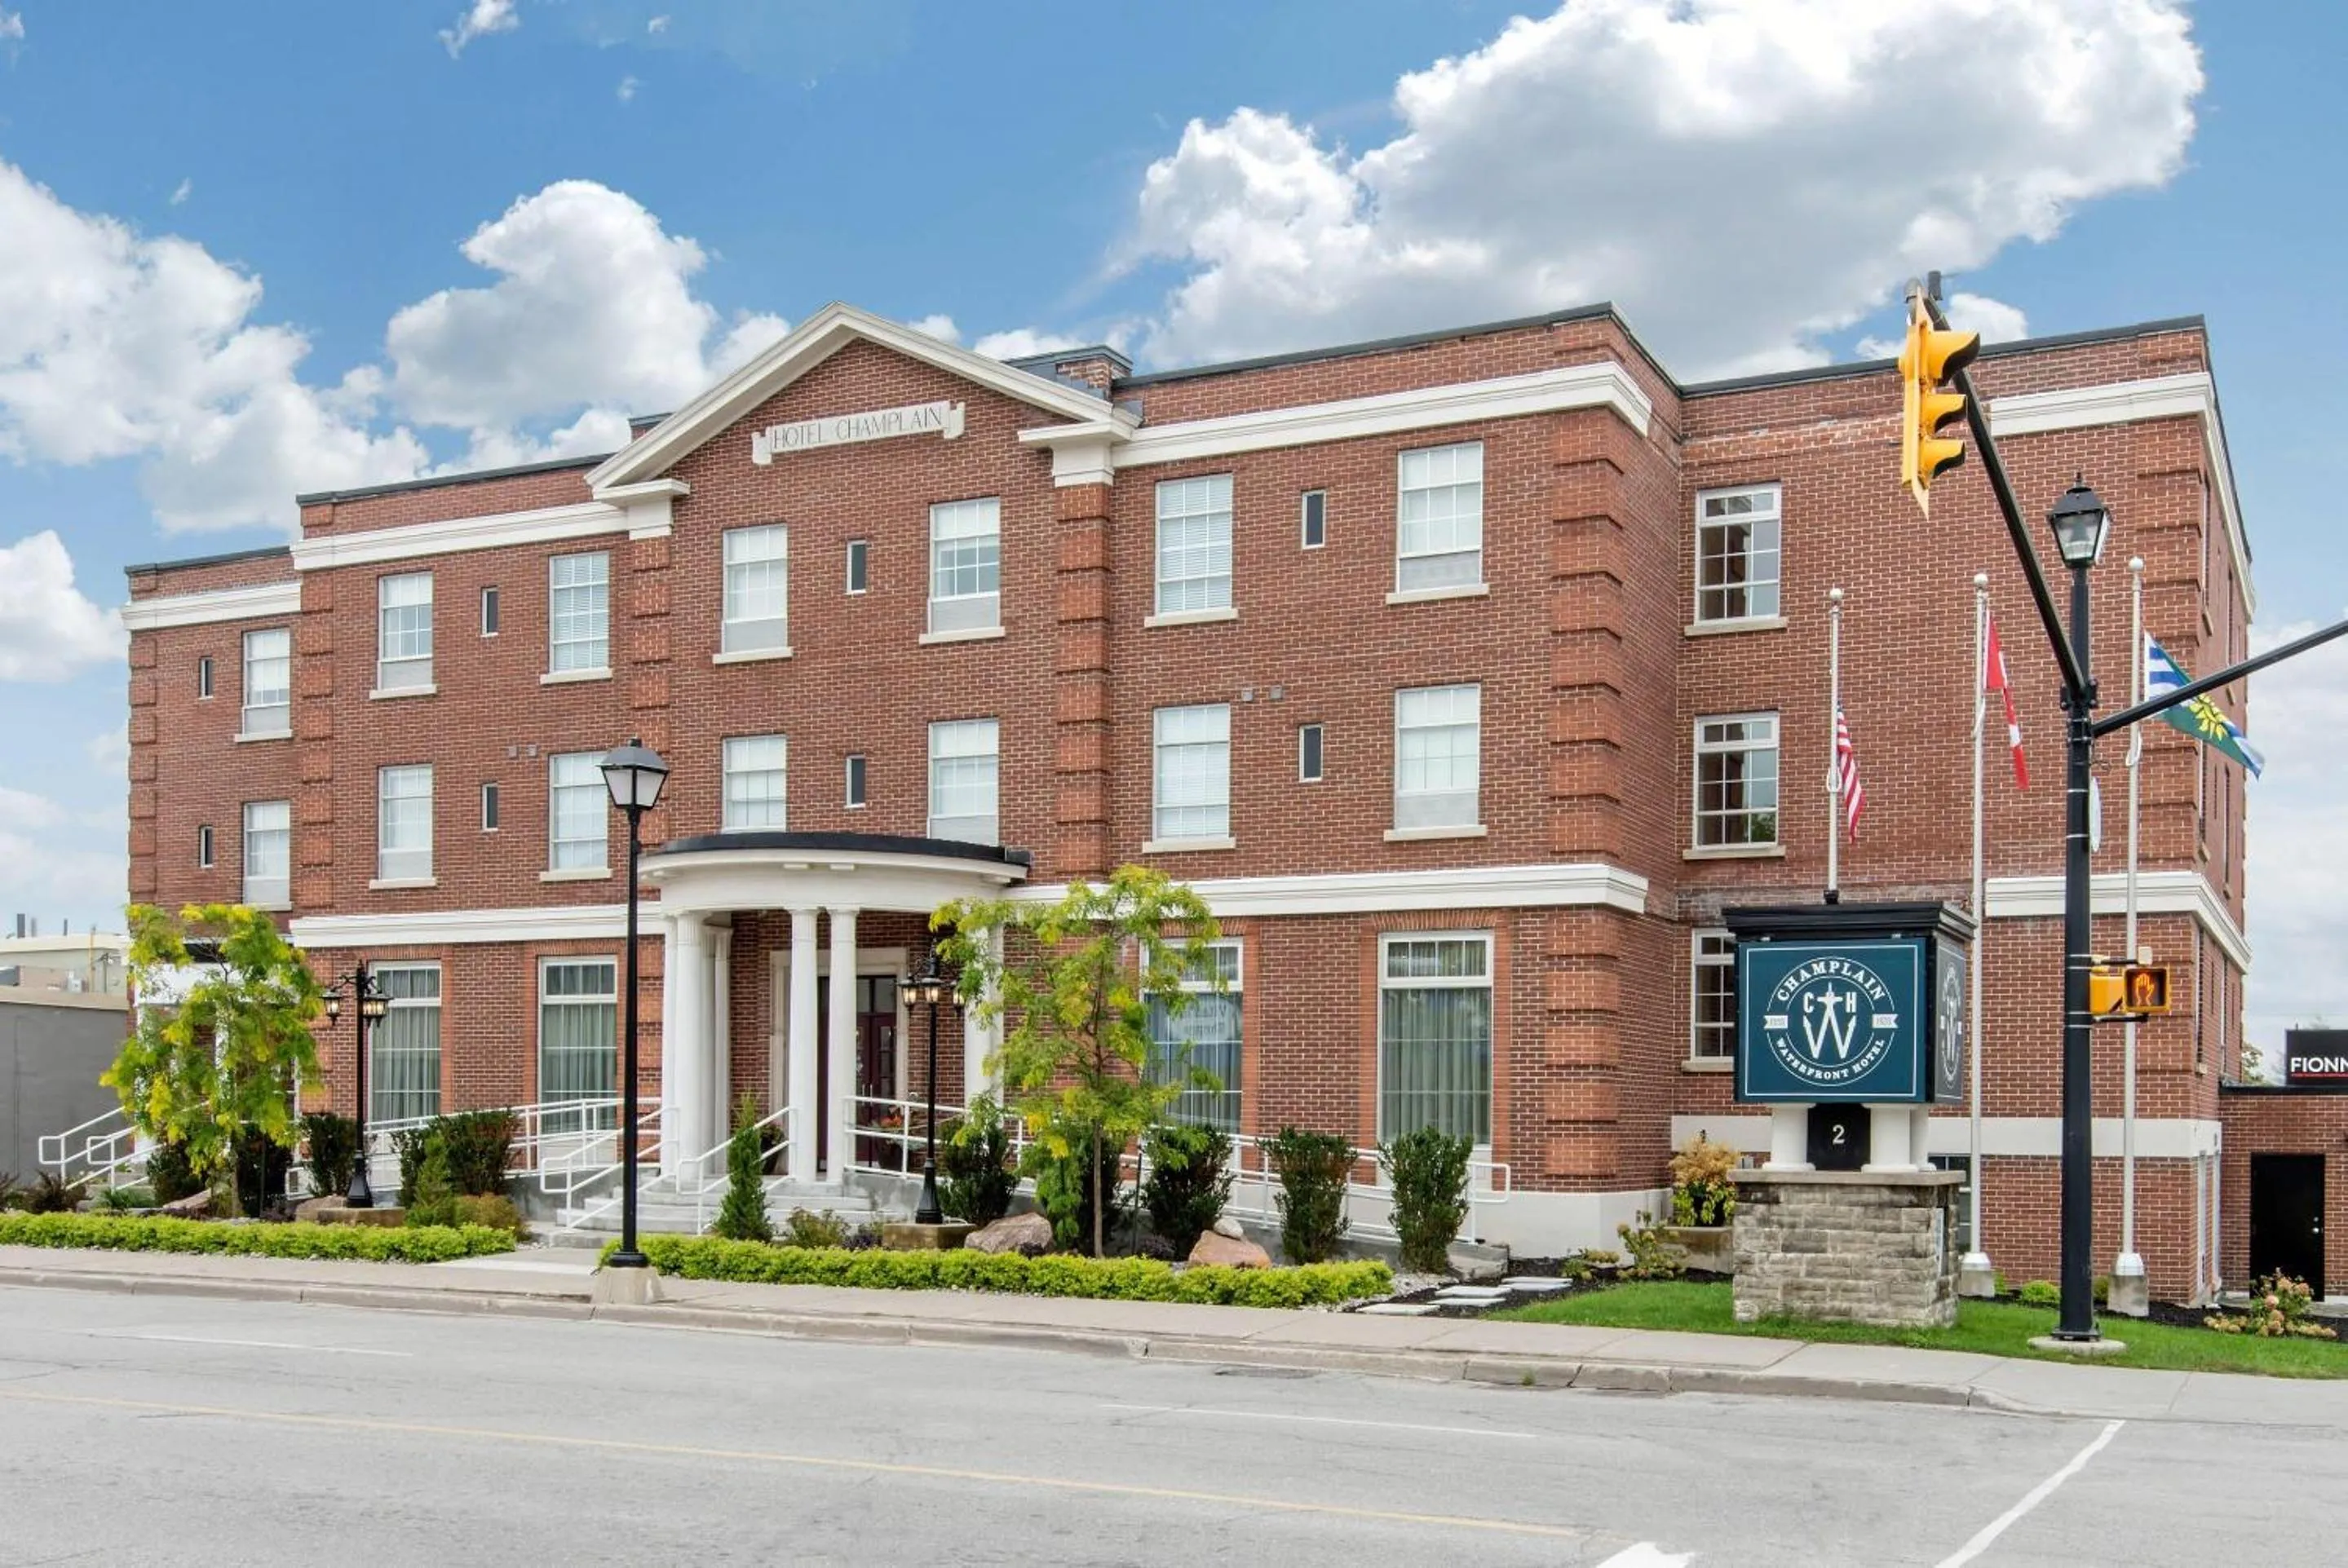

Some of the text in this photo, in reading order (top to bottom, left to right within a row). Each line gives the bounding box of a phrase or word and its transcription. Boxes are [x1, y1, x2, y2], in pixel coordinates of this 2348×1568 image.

[774, 406, 943, 449] HOTEL CHAMPLAIN
[1776, 960, 1886, 1002] CHAMPLAIN
[1776, 1037, 1886, 1080] WATERFRONT HOTEL
[1833, 1124, 1846, 1145] 2
